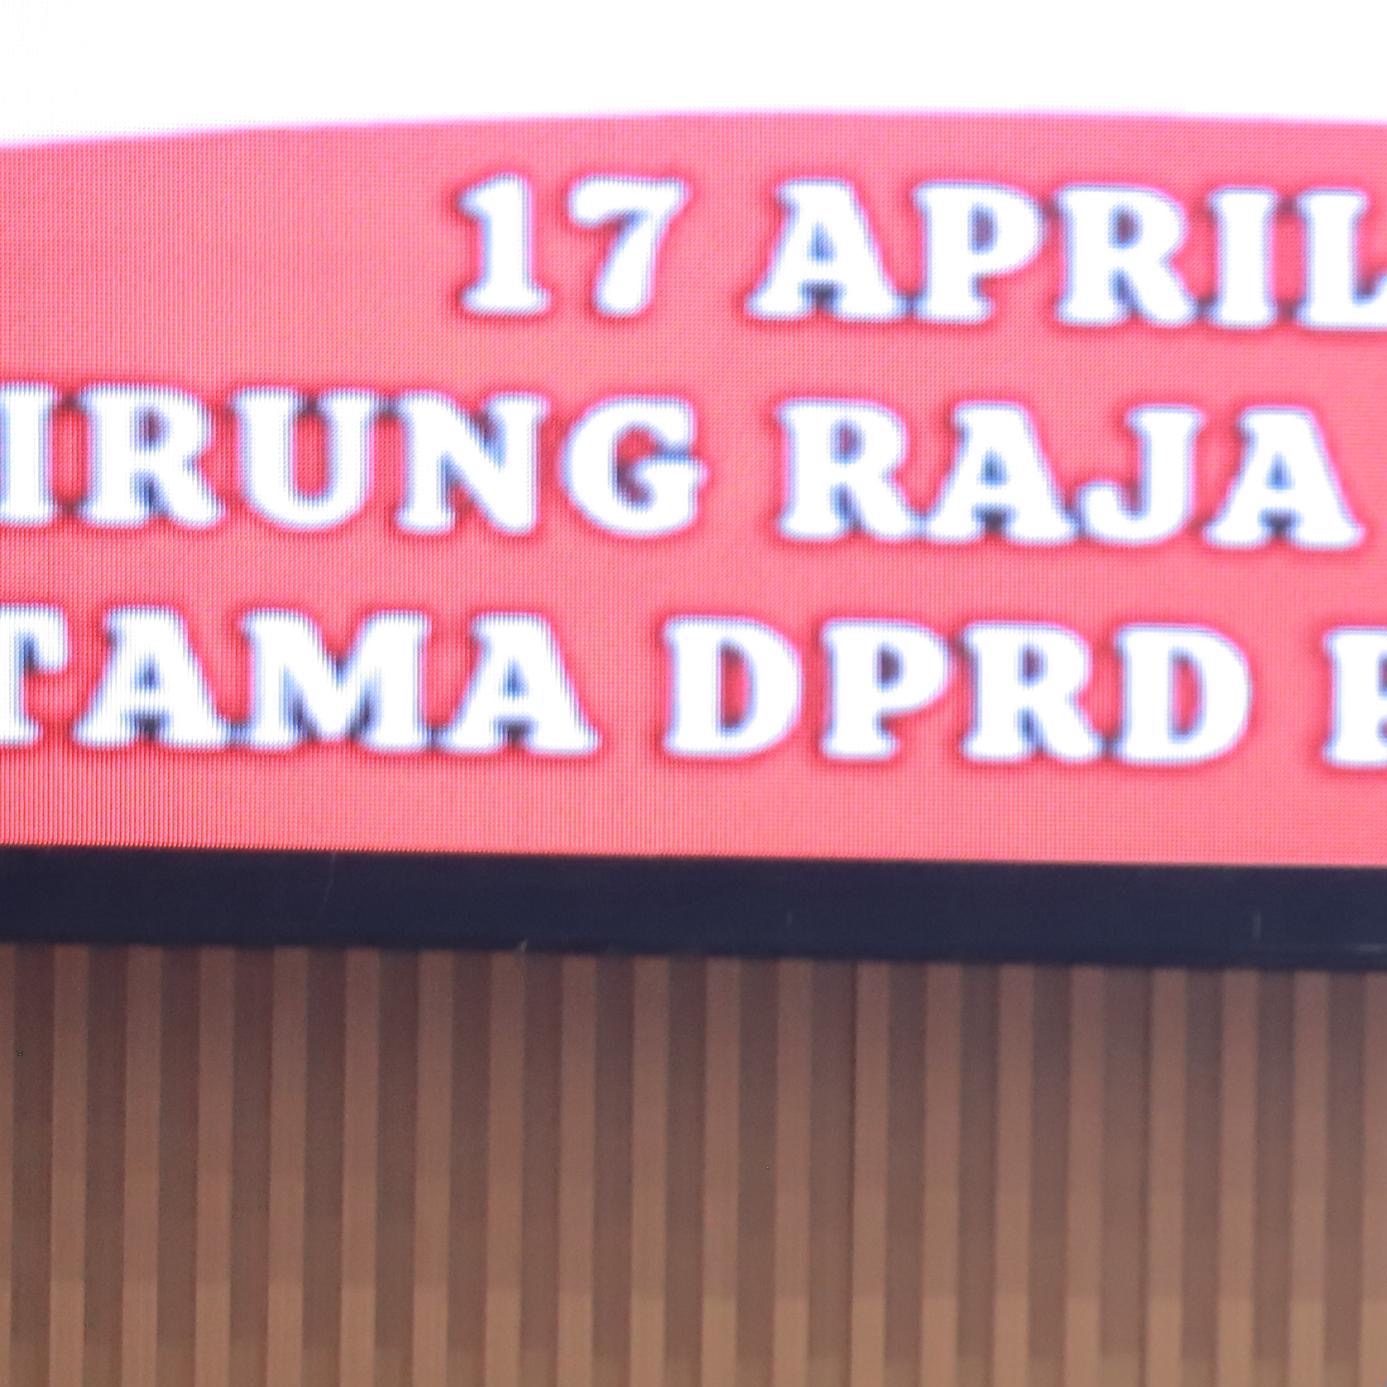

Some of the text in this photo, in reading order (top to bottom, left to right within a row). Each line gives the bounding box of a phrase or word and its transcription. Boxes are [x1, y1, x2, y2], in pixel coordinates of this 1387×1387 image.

[464, 173, 686, 316] 17
[779, 399, 1363, 549] RAJA
[664, 617, 1252, 764] DPRD
